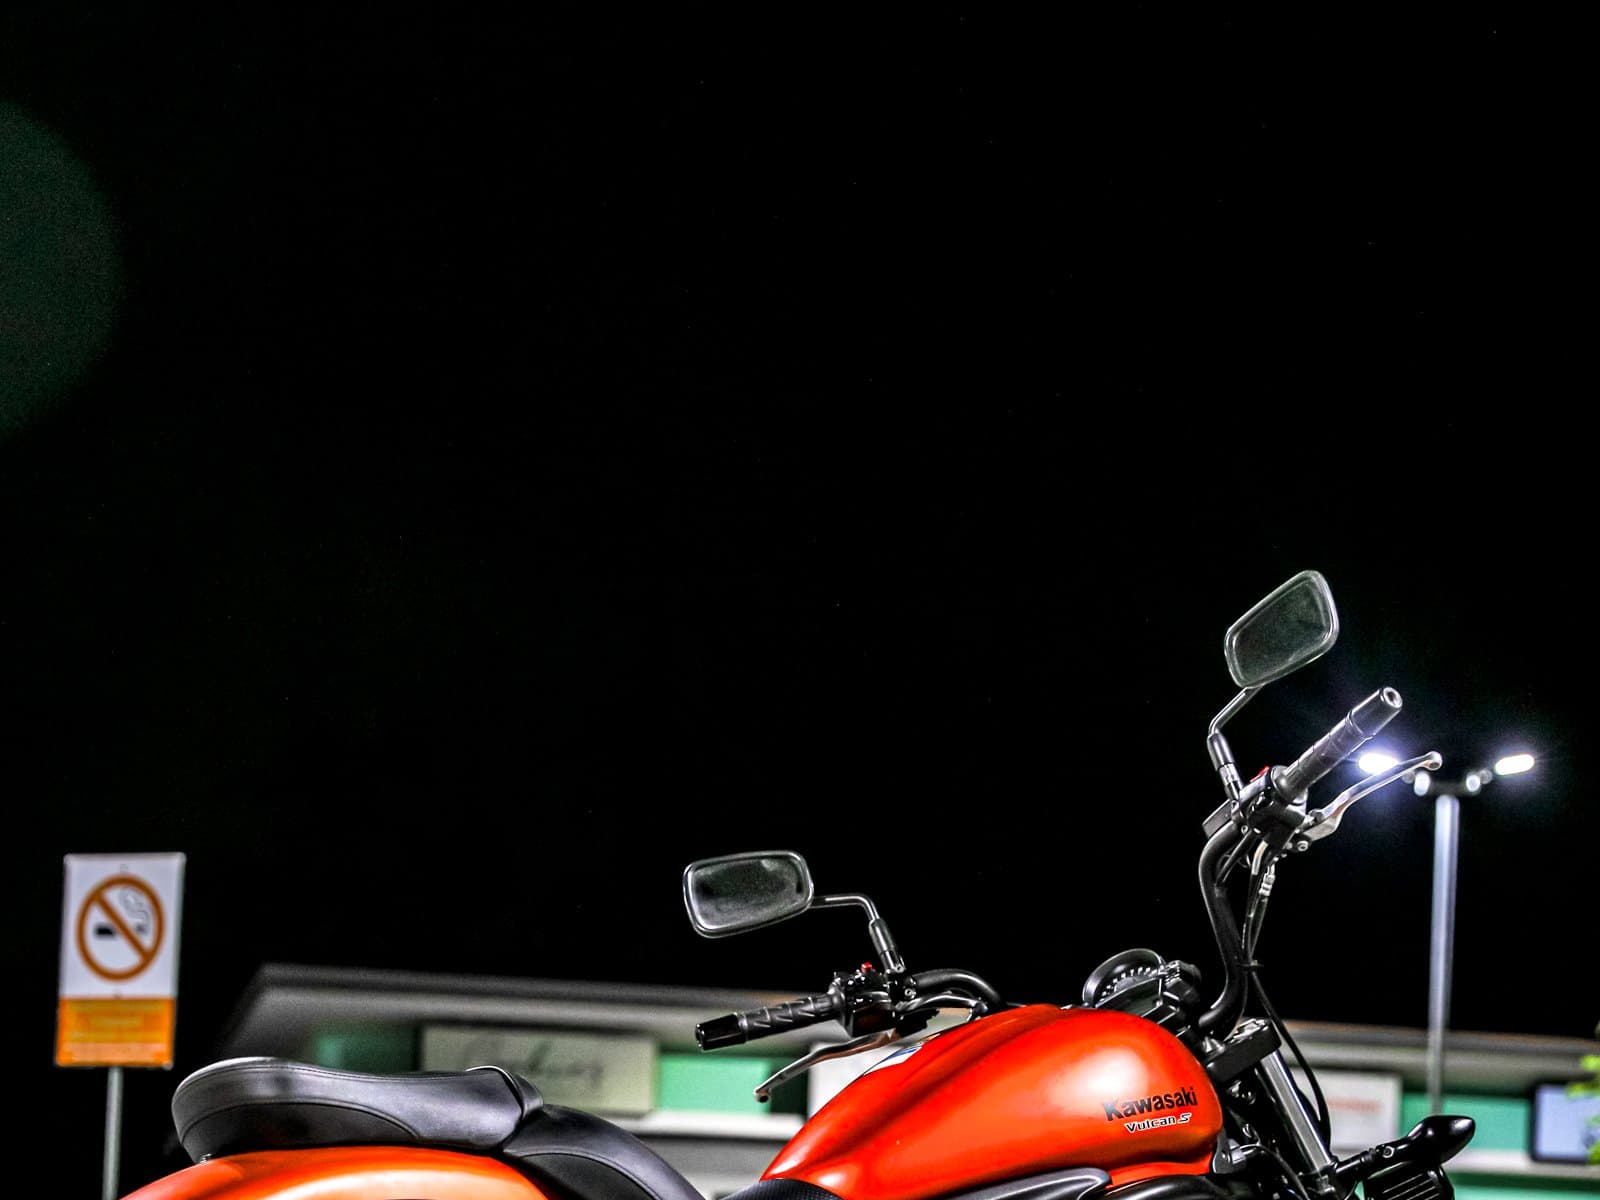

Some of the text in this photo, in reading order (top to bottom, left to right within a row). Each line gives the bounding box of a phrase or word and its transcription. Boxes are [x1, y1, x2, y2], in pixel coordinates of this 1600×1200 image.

[1103, 1086, 1198, 1121] Kawasaki
[1124, 1112, 1192, 1133] Vulcan S
